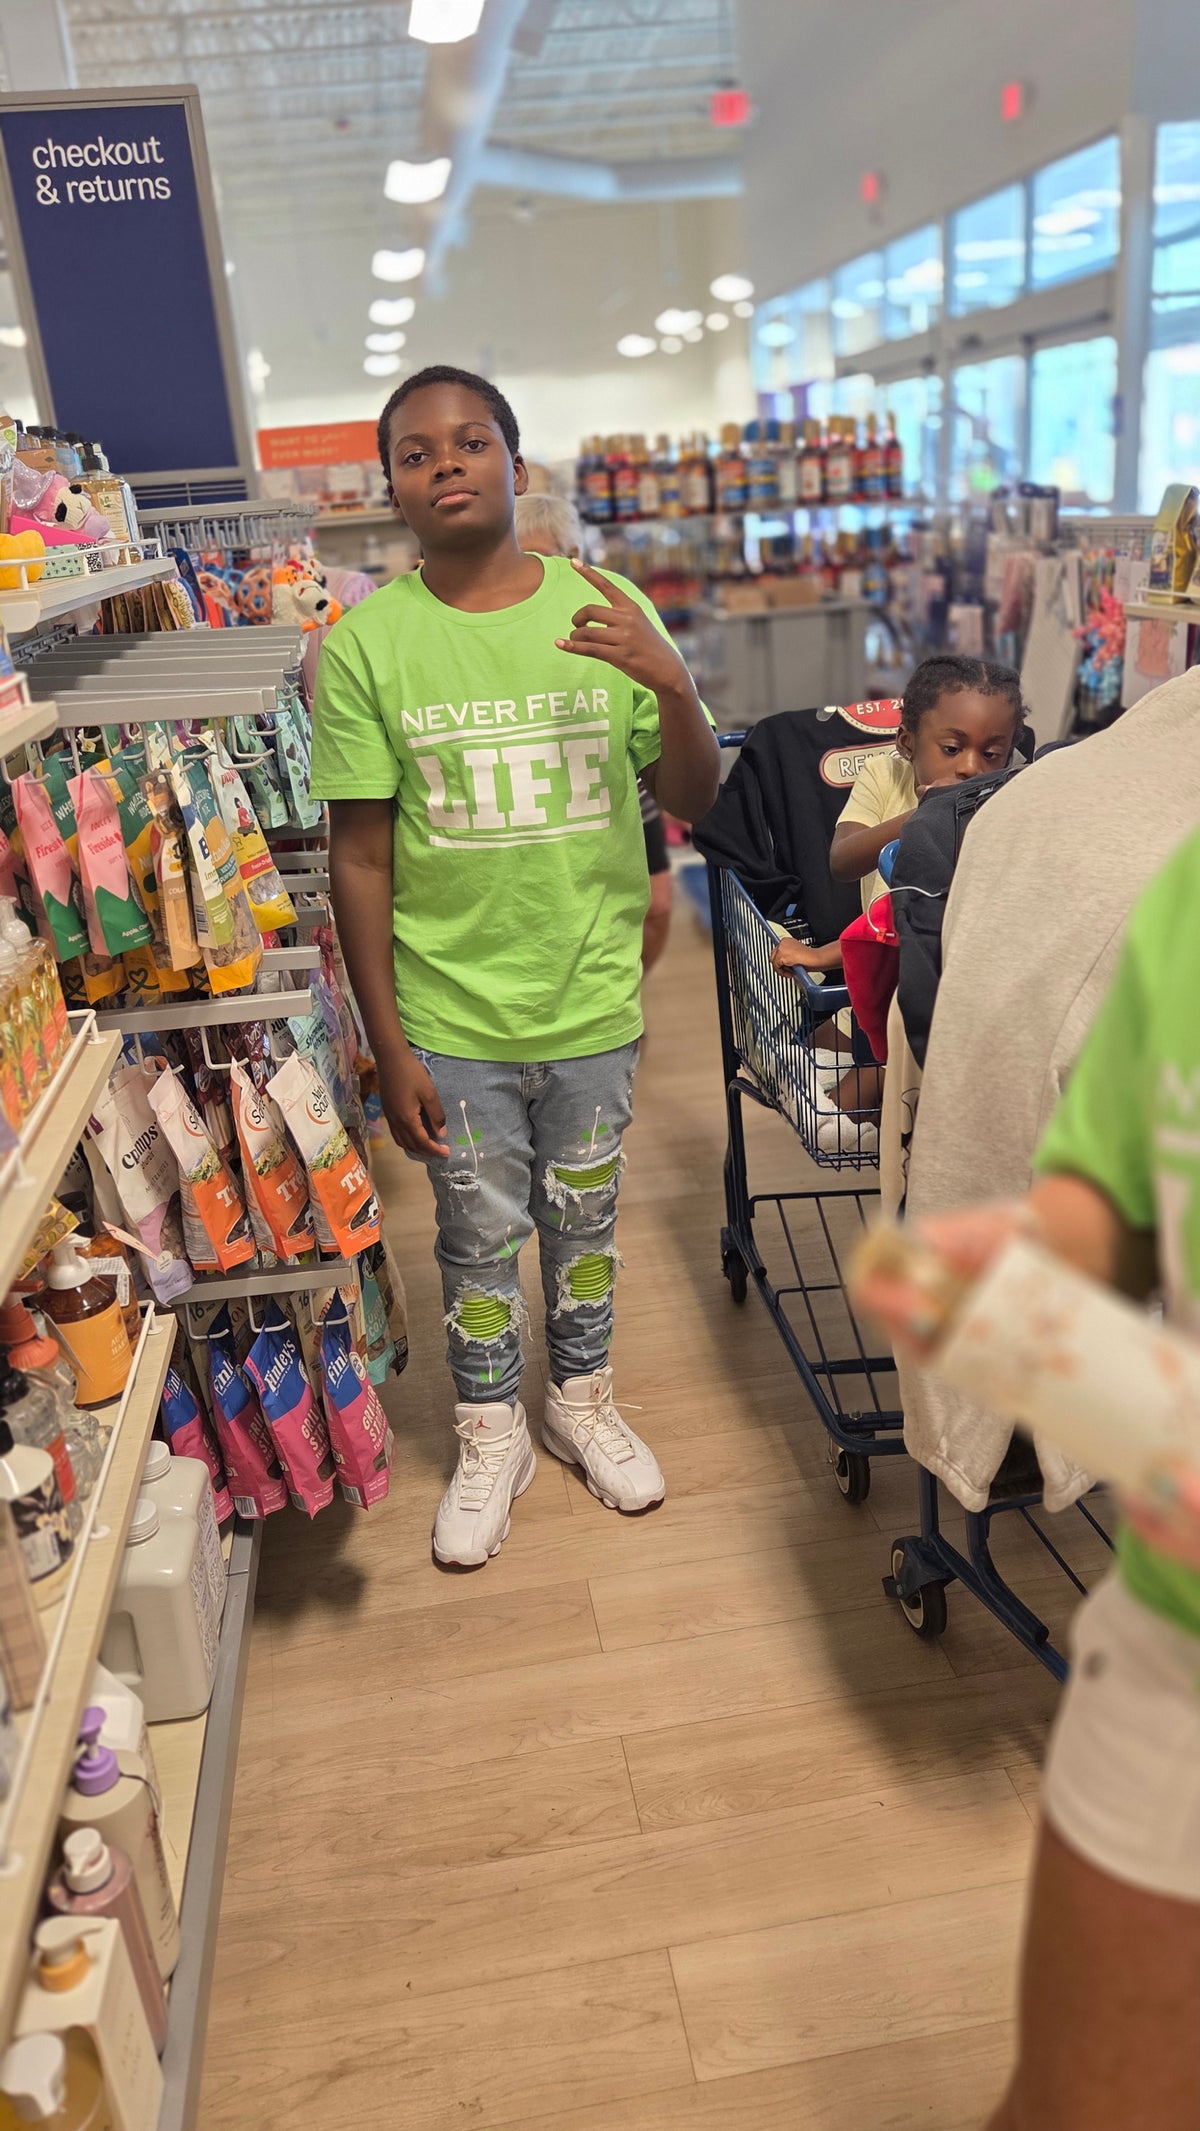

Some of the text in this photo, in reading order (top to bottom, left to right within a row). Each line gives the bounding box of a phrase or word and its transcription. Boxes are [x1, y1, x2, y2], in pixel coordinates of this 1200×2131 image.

[32, 135, 165, 169] checkout
[36, 174, 171, 205] & returns
[401, 688, 610, 734] NEVER FEAR
[856, 702, 886, 715] EST.
[415, 737, 611, 830] LIFE
[87, 833, 117, 856] Fireside
[263, 1339, 297, 1393] Finley's
